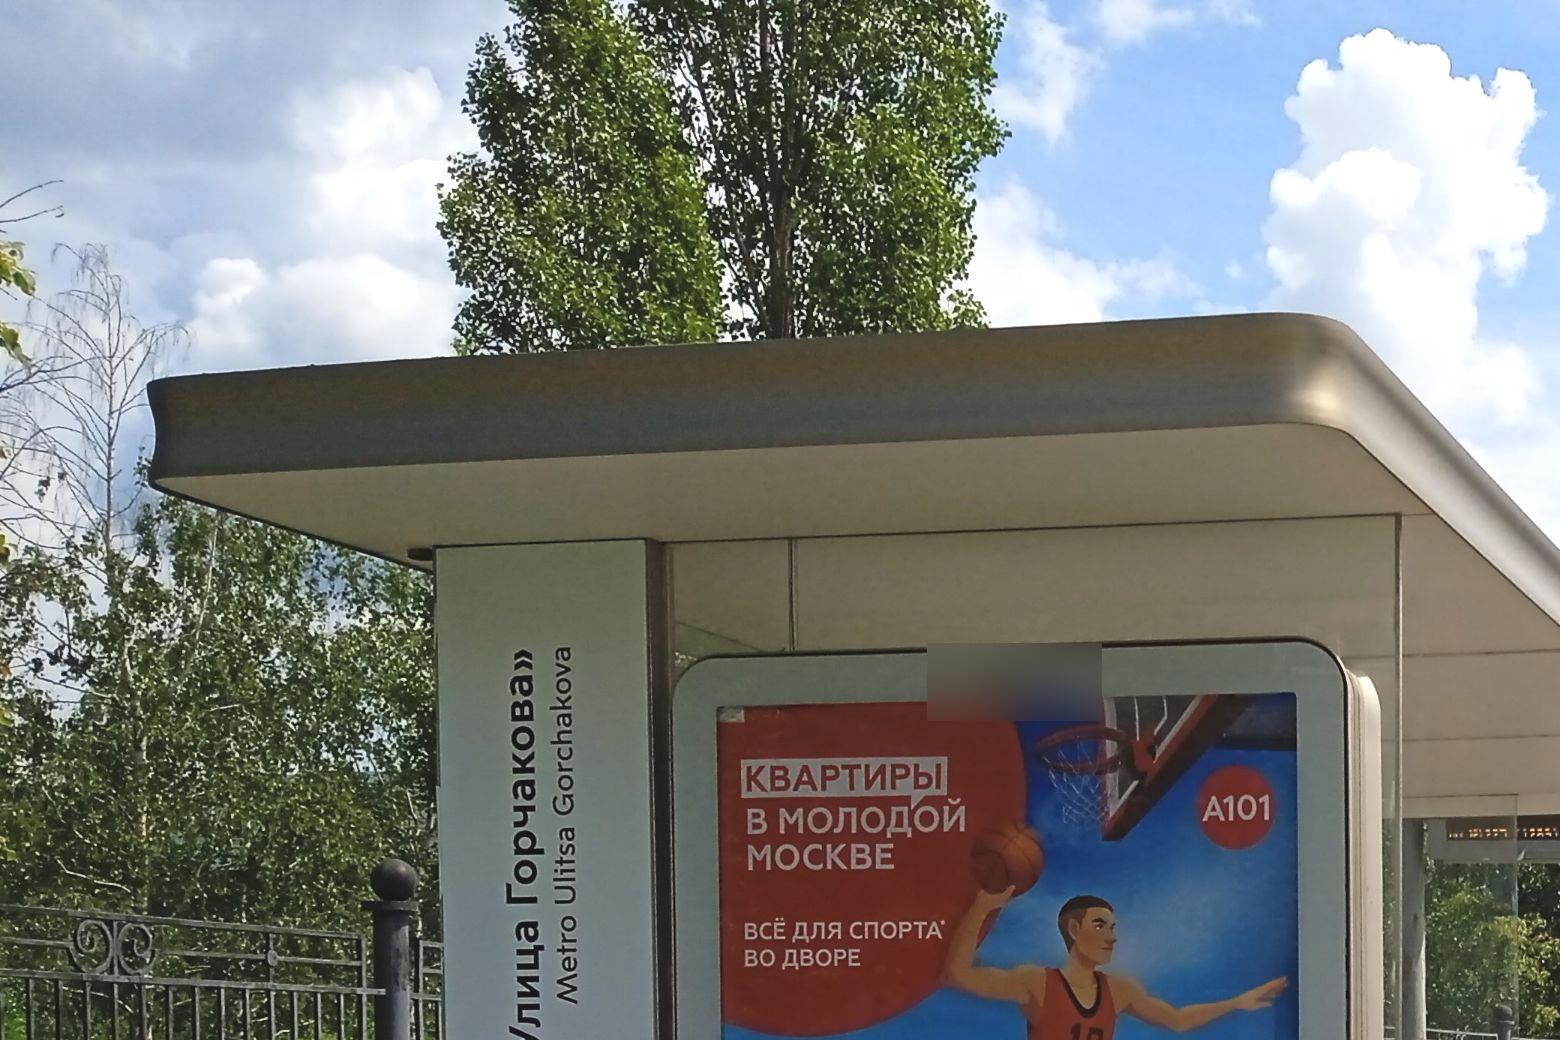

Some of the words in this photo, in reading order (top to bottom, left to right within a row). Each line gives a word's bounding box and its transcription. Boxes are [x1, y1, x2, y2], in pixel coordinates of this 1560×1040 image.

[549, 647, 574, 816] Gorchakova
[506, 649, 545, 904] Горчакова»
[745, 763, 942, 793] КВАРТИРЫ
[747, 808, 768, 835] В
[779, 798, 966, 838] МОЛОДОЙ
[553, 827, 577, 904] Ulitsa
[747, 843, 895, 871] МОСКВЕ
[744, 917, 786, 940] ВСЁ
[792, 922, 842, 943] ДЛЯ
[556, 915, 578, 1004] Metro
[744, 949, 775, 968] ВО
[782, 949, 861, 970] ДВОРЕ
